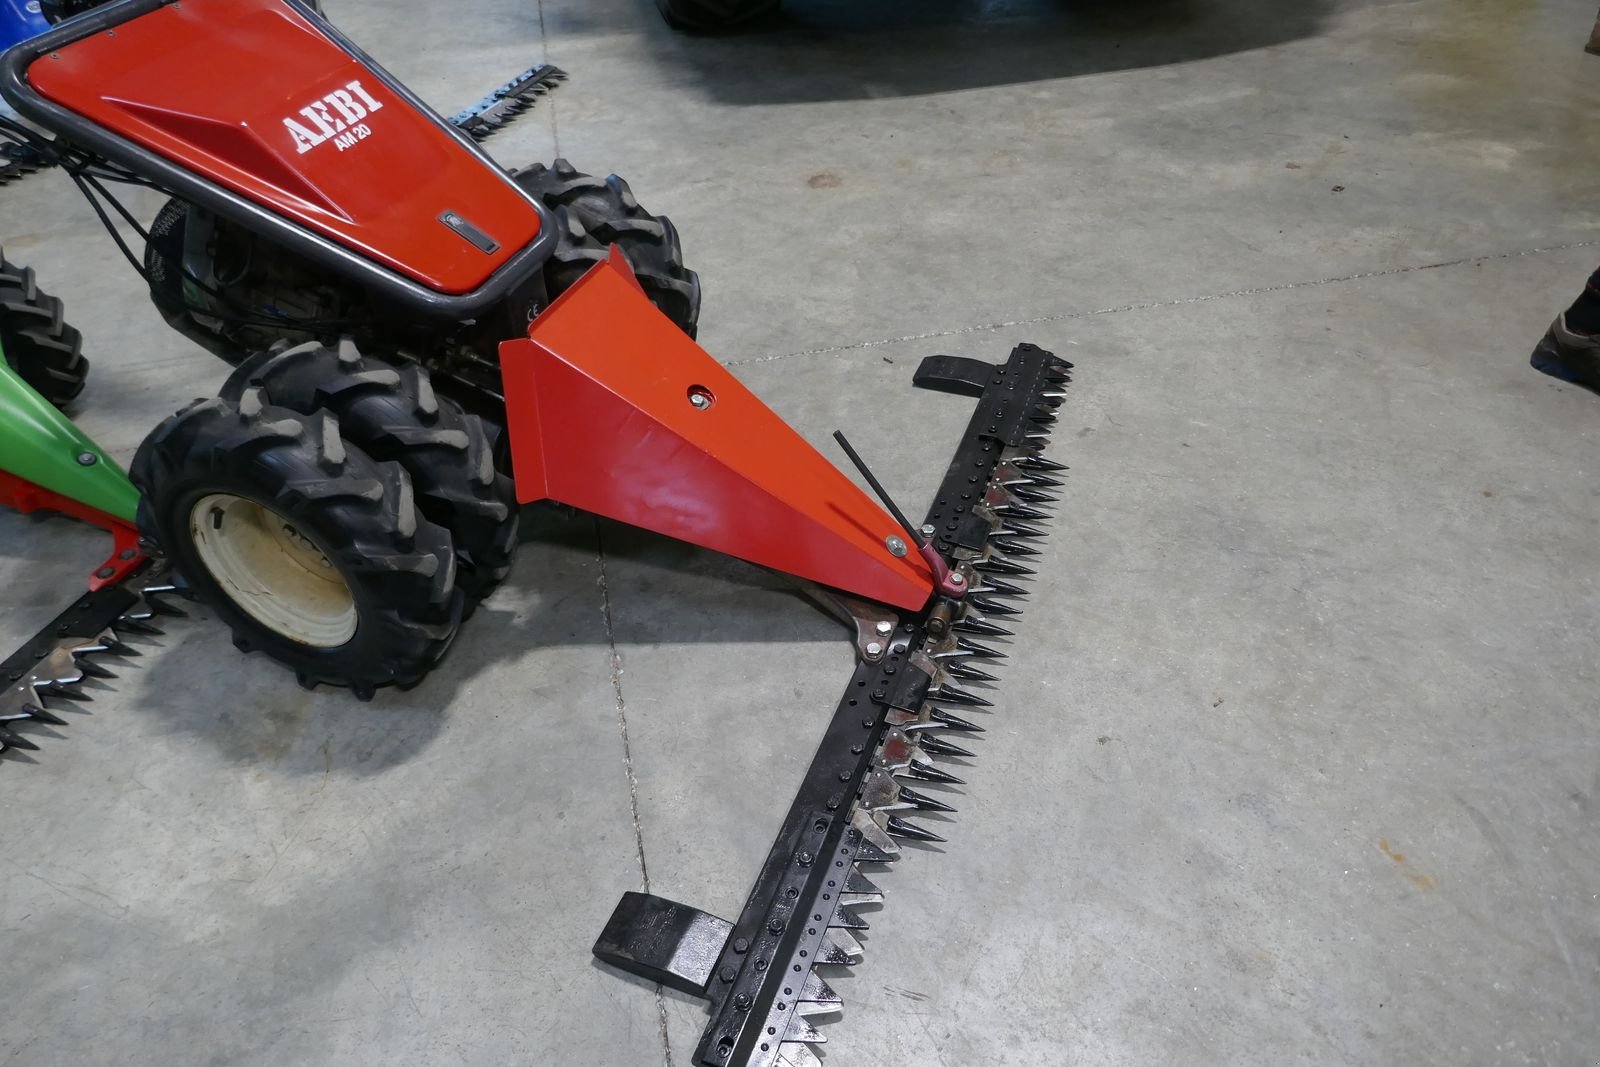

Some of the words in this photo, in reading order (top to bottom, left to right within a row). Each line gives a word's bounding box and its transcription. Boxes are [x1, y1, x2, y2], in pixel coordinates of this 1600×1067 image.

[282, 80, 383, 154] AEBI
[334, 131, 358, 152] AM
[353, 123, 372, 140] 20
